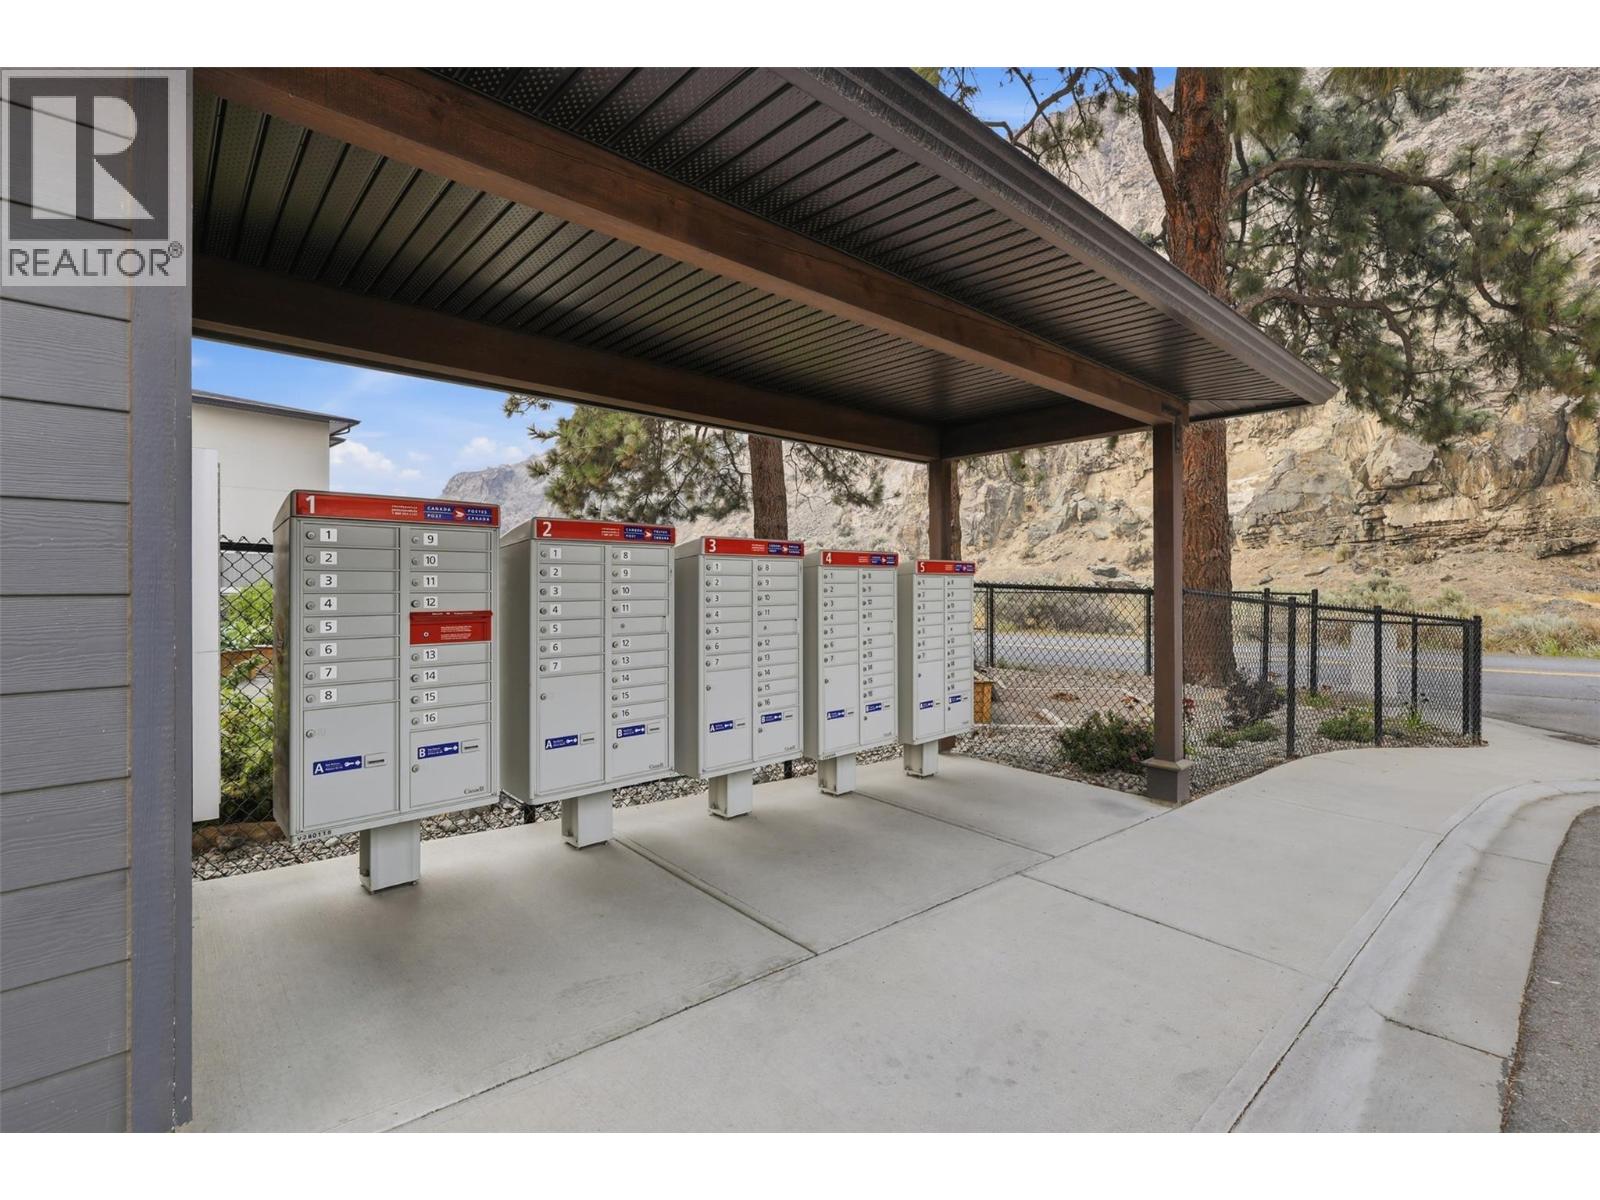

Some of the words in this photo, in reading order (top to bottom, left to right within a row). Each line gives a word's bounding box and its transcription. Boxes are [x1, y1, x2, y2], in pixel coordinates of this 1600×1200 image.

[305, 494, 316, 514] 1
[542, 522, 552, 537] 2
[326, 530, 331, 540] 1
[427, 534, 434, 544] 9
[708, 539, 716, 552] 3
[325, 552, 333, 563] 2
[553, 549, 558, 557] 1
[623, 551, 629, 560] 8
[825, 552, 832, 564] 4
[426, 555, 436, 565] 10
[553, 567, 559, 577] 2
[920, 562, 925, 572] 5
[325, 575, 333, 586] 3
[426, 577, 435, 586] 11
[553, 586, 559, 595] 3
[324, 598, 332, 608] 4
[426, 597, 436, 607] 12
[325, 621, 333, 632] 5
[552, 623, 559, 633] 5
[552, 643, 559, 652] 6
[622, 639, 630, 647] 12
[324, 644, 333, 655] 6
[425, 650, 436, 660] 13
[622, 656, 630, 664] 13
[552, 661, 558, 670] 7
[325, 667, 332, 677] 7
[425, 671, 436, 680] 14
[324, 690, 333, 701] 8
[424, 692, 436, 701] 15
[425, 713, 436, 722] 16
[622, 709, 630, 717] 16
[618, 729, 623, 737] B
[545, 740, 553, 749] A
[419, 748, 426, 758] B
[314, 763, 324, 774] A
